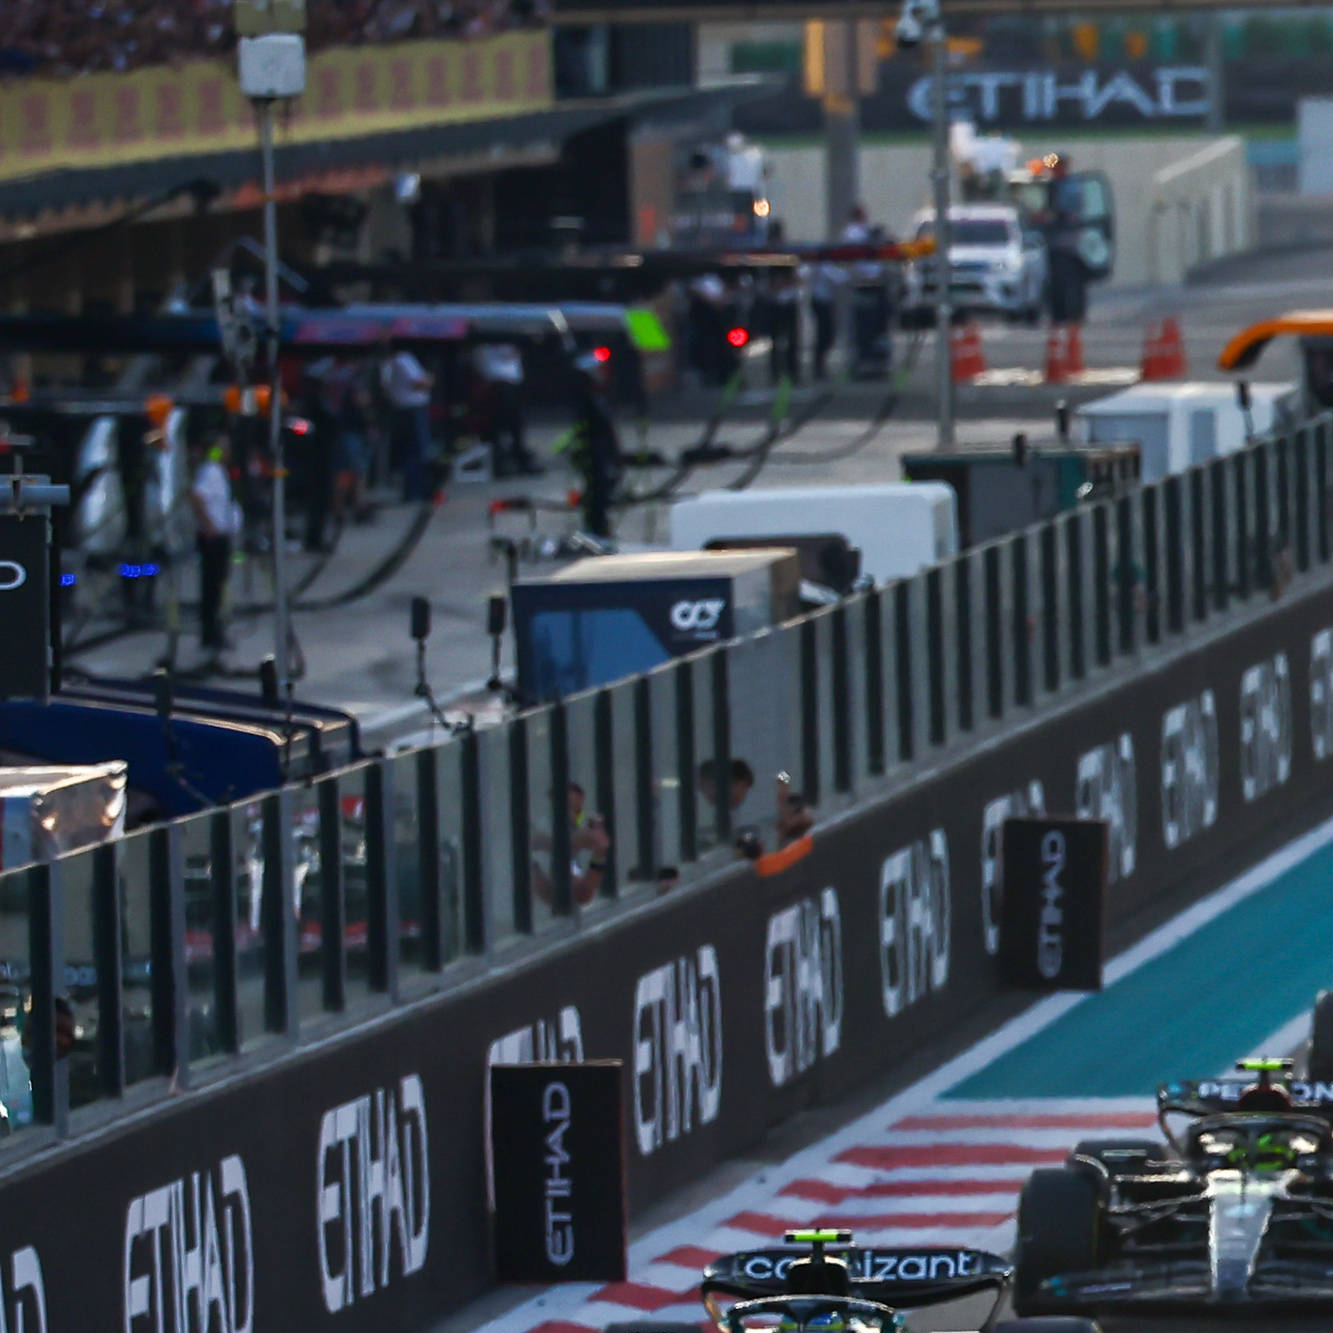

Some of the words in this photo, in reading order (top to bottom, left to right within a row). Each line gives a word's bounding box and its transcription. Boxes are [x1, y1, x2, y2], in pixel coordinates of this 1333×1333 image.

[633, 945, 722, 1155] ETIHAD
[316, 1073, 430, 1313] ETIHAD
[543, 1080, 573, 1266] ETIHAD
[744, 1250, 971, 1282] coizant
